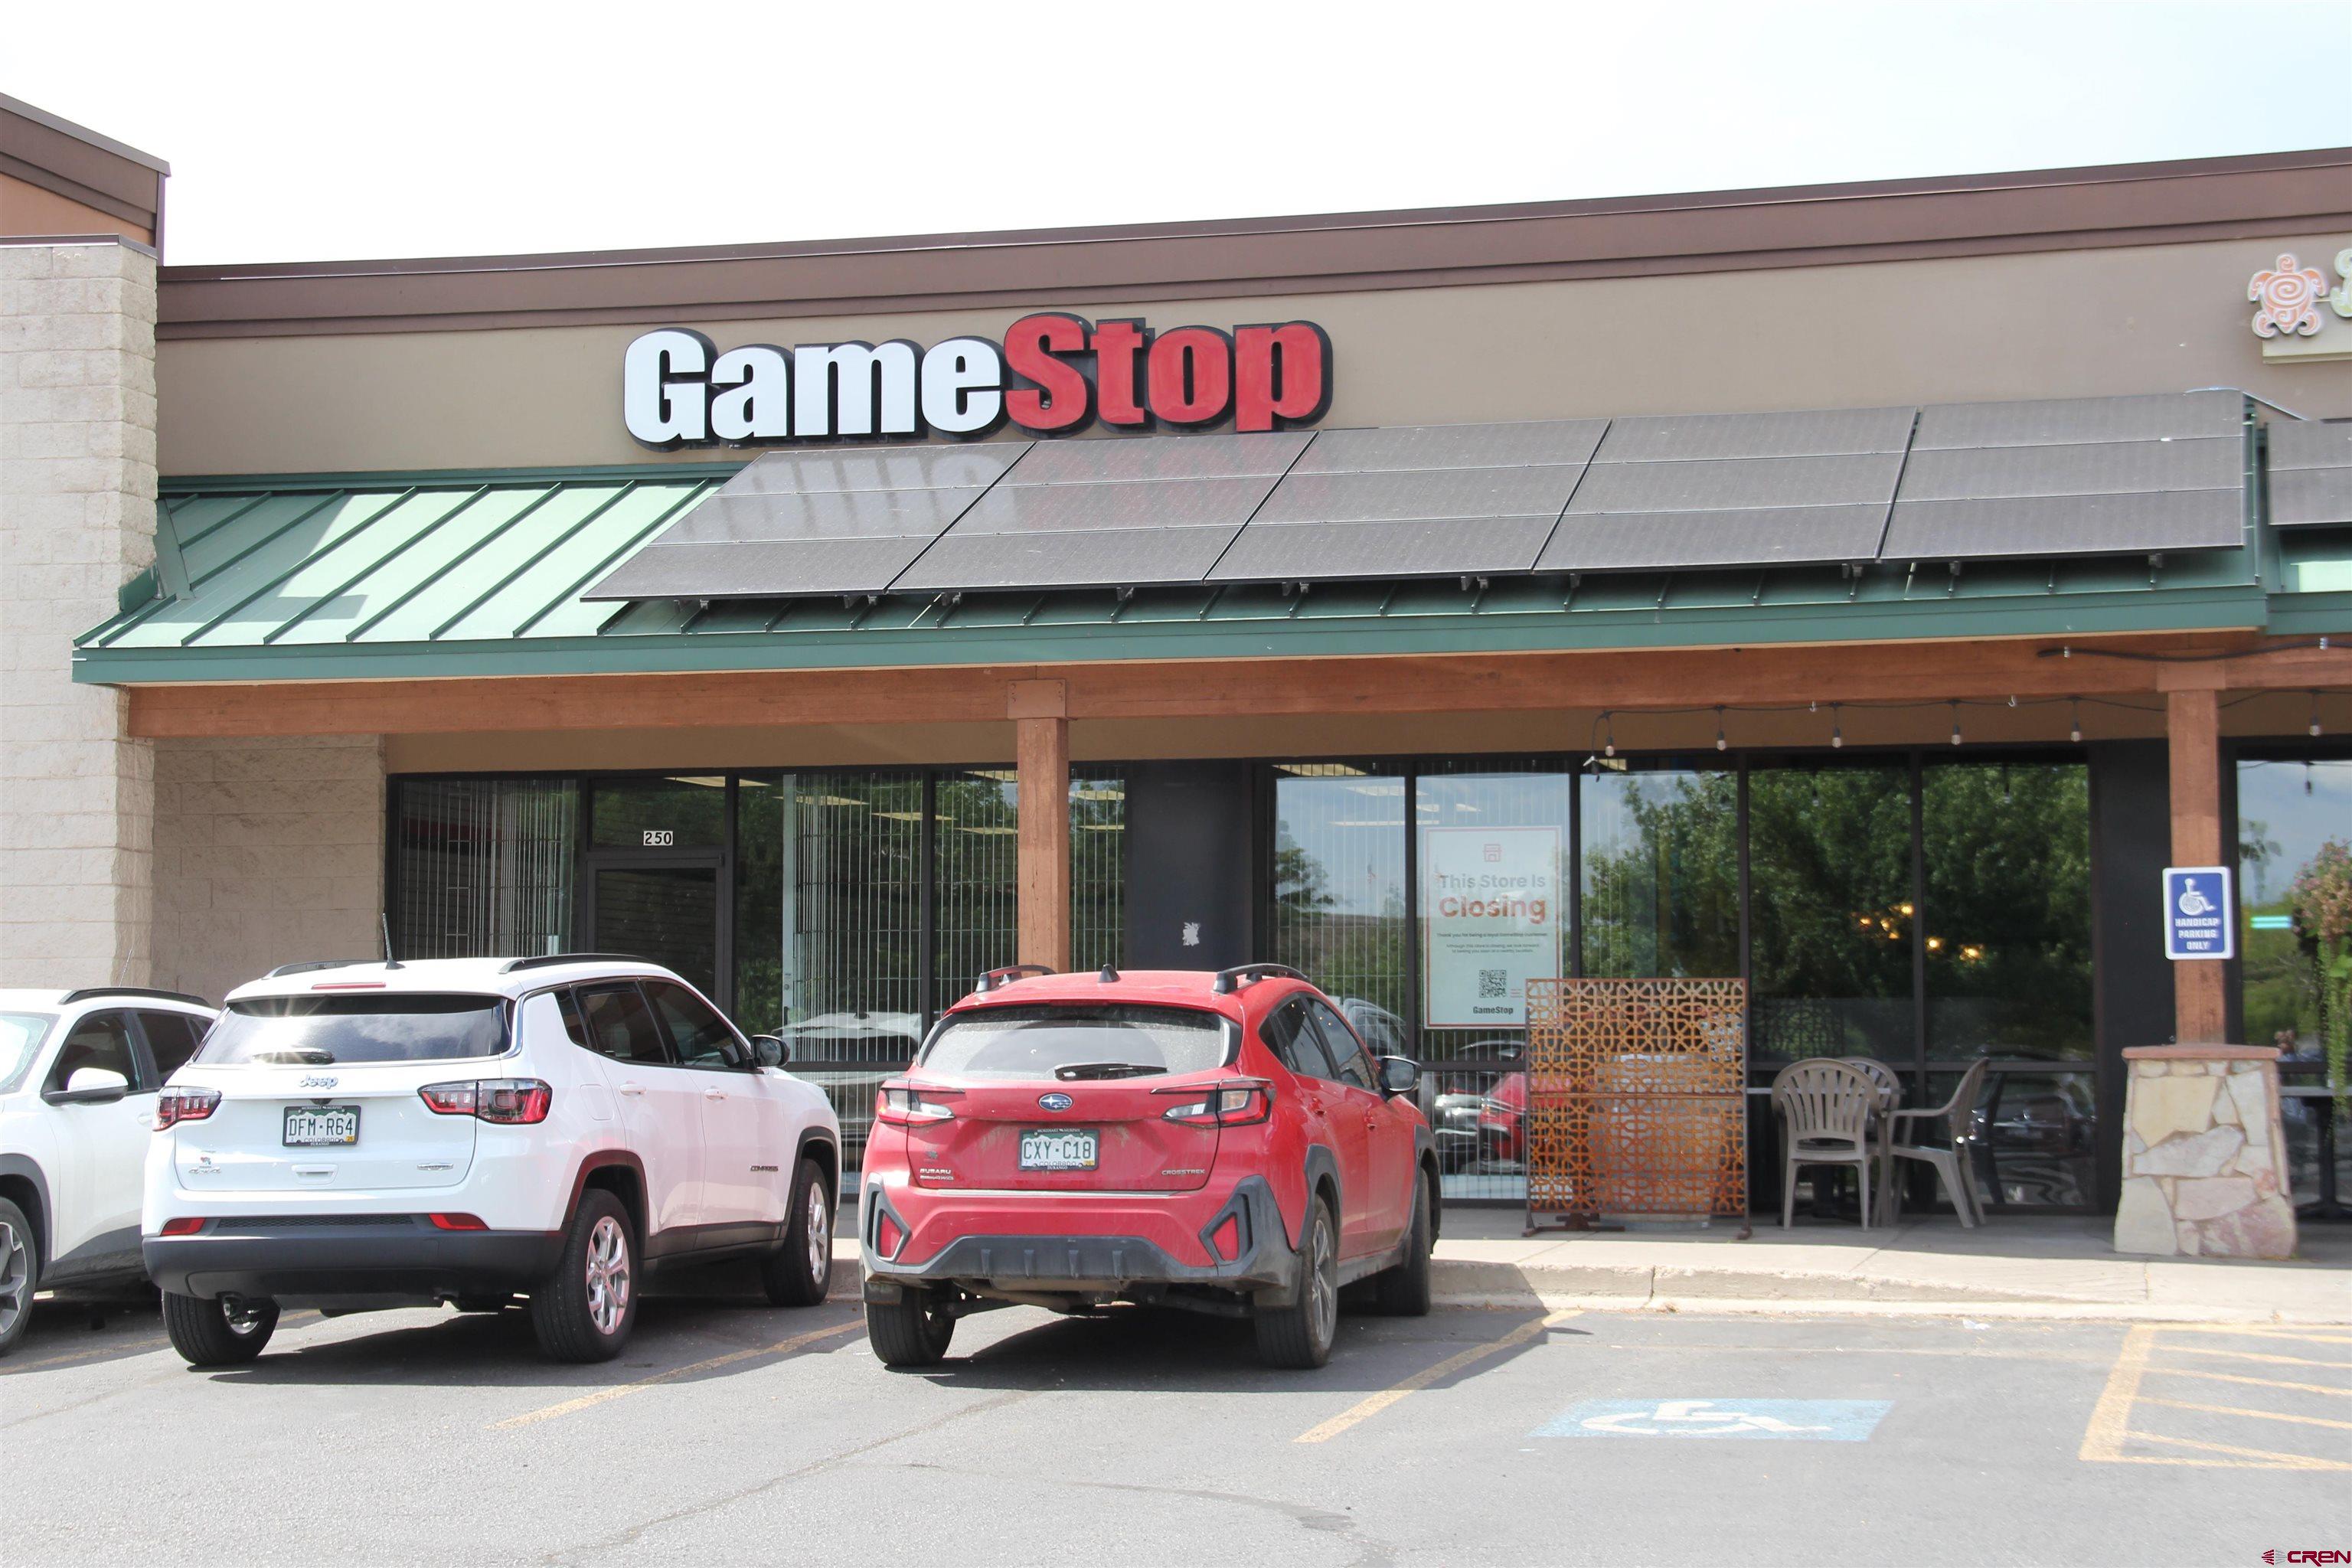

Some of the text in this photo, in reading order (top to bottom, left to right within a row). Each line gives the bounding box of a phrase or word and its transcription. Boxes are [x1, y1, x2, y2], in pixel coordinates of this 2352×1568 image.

[622, 312, 1331, 446] GameStop
[645, 831, 672, 844] 250
[1439, 874, 1546, 888] This Store Is
[1439, 894, 1546, 925] Closing
[2175, 918, 2219, 927] HANDICAP
[2178, 929, 2217, 939] PARKING
[2186, 940, 2210, 950] ONLY
[1472, 1006, 1514, 1014] GameStop
[299, 1073, 338, 1089] Jeep
